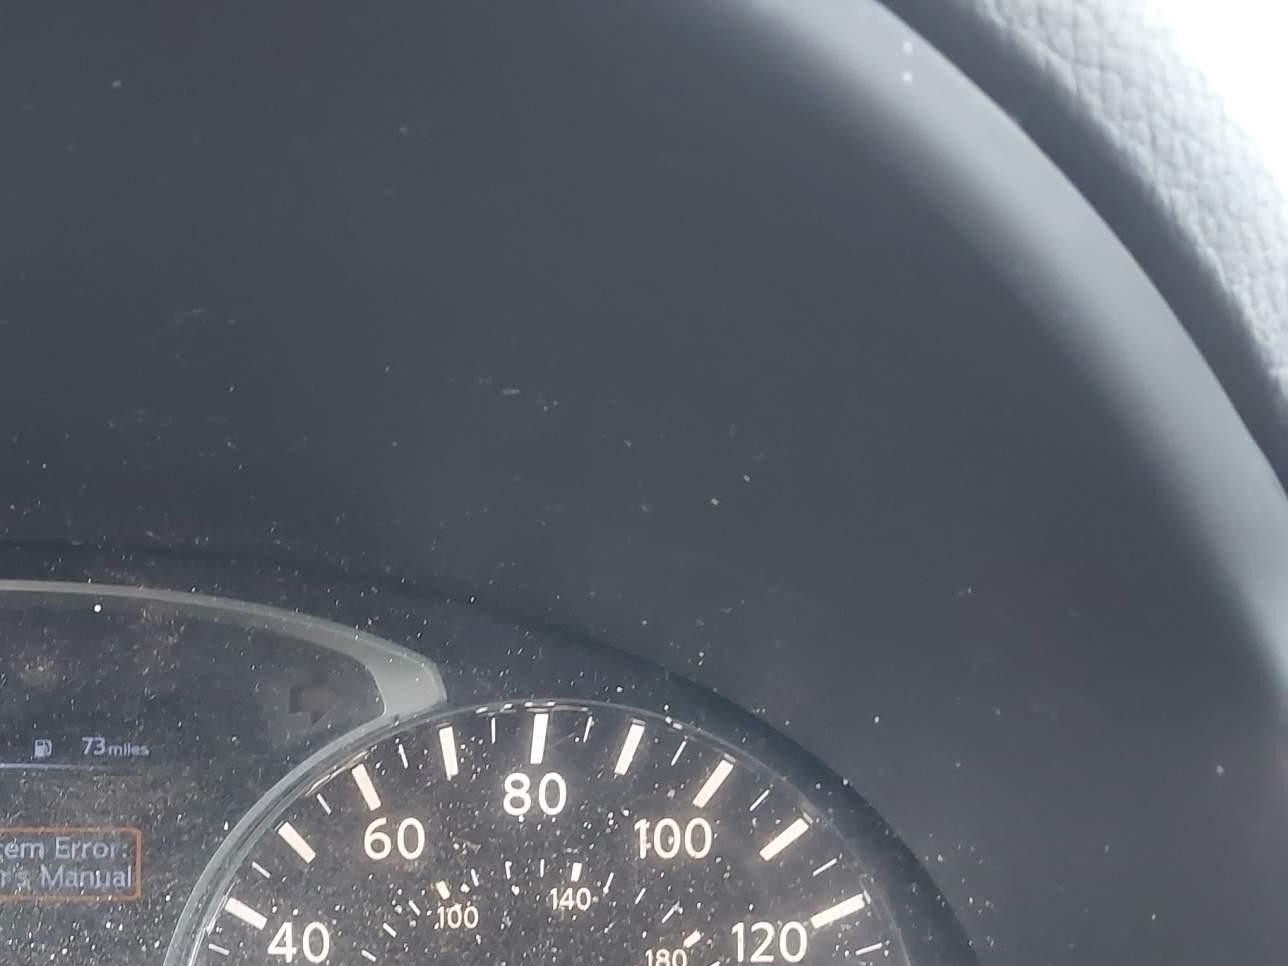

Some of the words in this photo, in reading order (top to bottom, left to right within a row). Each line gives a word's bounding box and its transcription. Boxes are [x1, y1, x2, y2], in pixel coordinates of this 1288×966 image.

[82, 737, 105, 755] 73
[108, 744, 149, 757] miles
[503, 773, 567, 816] 80
[363, 818, 425, 859] 60
[635, 817, 712, 859] 100
[41, 864, 133, 888] Manual
[436, 906, 479, 929] 100
[550, 887, 592, 911] 140
[268, 922, 330, 962] 40
[731, 922, 808, 962] 120
